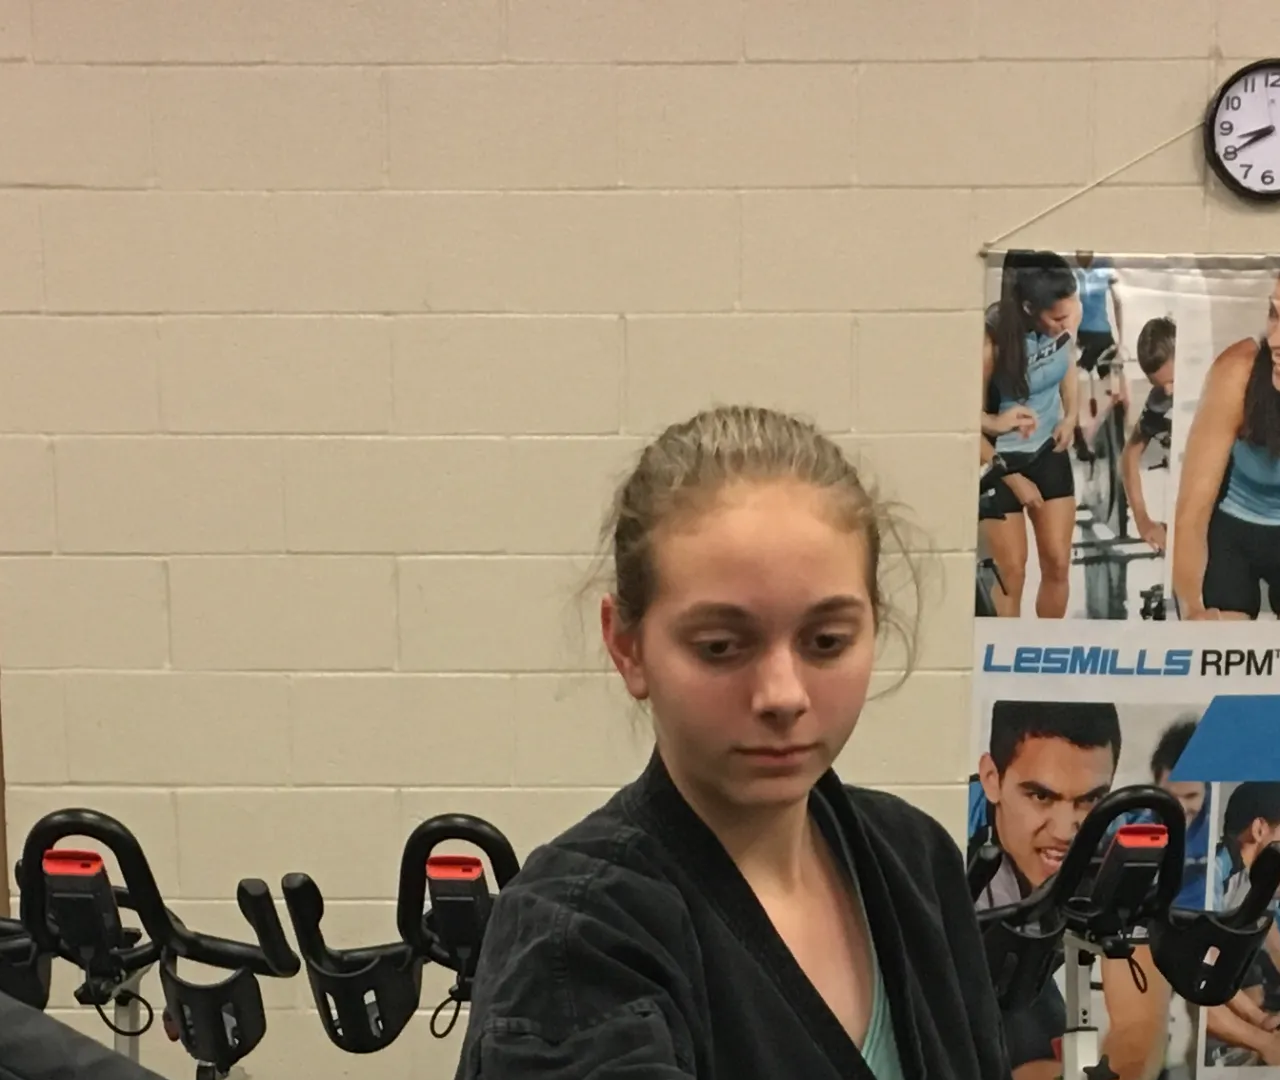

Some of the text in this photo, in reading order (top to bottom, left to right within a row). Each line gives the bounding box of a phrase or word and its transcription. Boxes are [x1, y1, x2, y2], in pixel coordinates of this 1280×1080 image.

[1243, 77, 1255, 93] 11
[1225, 95, 1242, 111] 10
[1220, 121, 1234, 136] 9
[1223, 145, 1238, 161] 8
[1239, 164, 1253, 180] 7
[1260, 170, 1275, 185] 6
